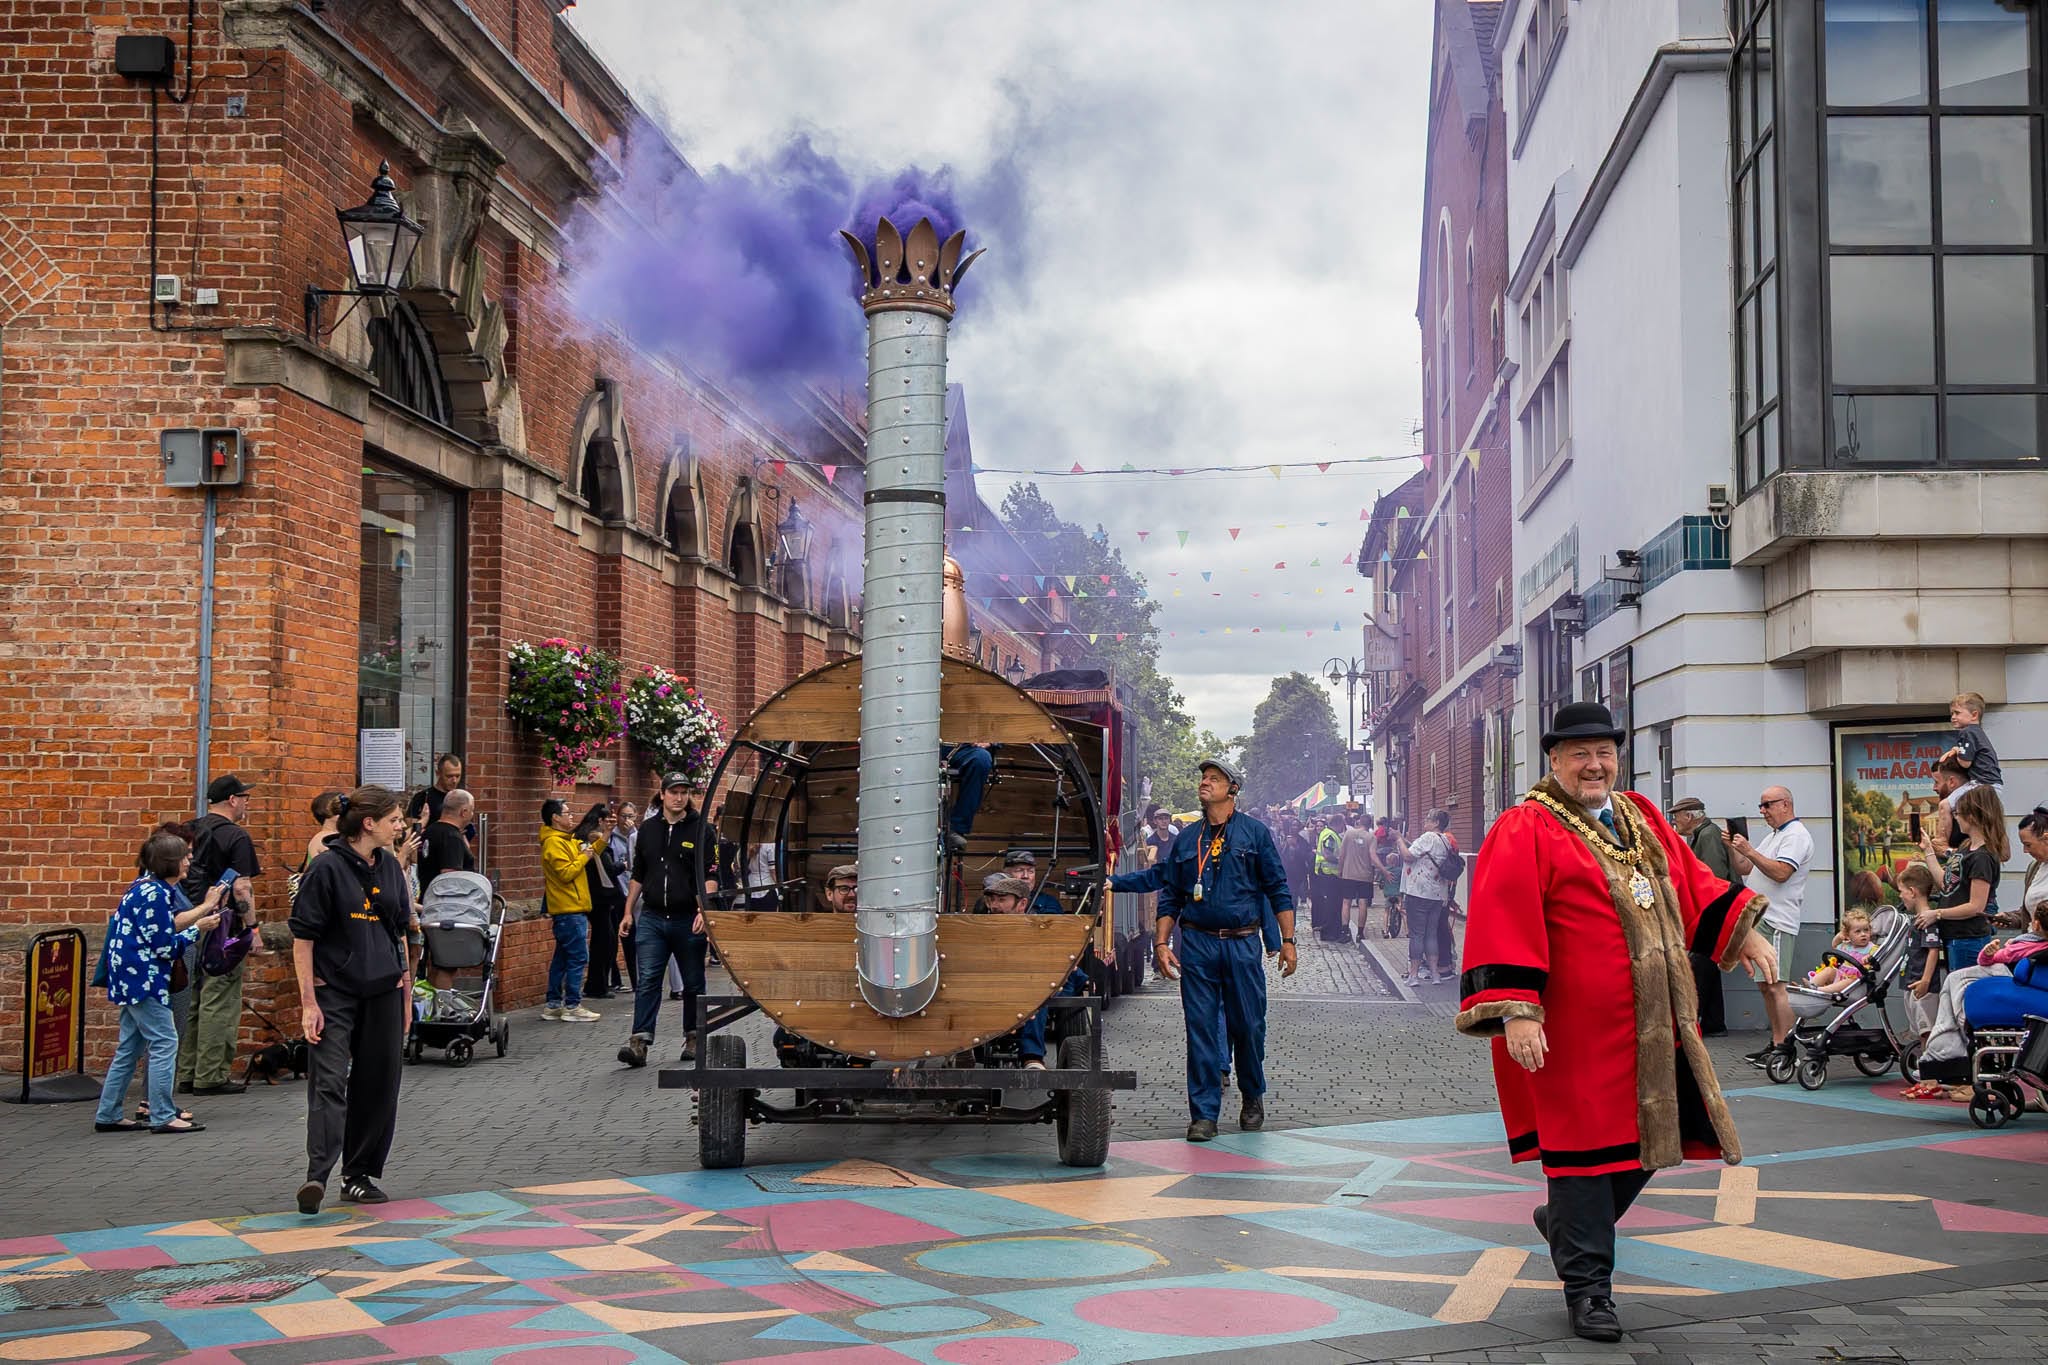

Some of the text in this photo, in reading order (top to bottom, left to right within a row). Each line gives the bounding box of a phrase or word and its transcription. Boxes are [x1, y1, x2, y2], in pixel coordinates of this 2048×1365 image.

[1864, 742, 1942, 760] TIME AND
[1857, 760, 1933, 780] TIME AGA
